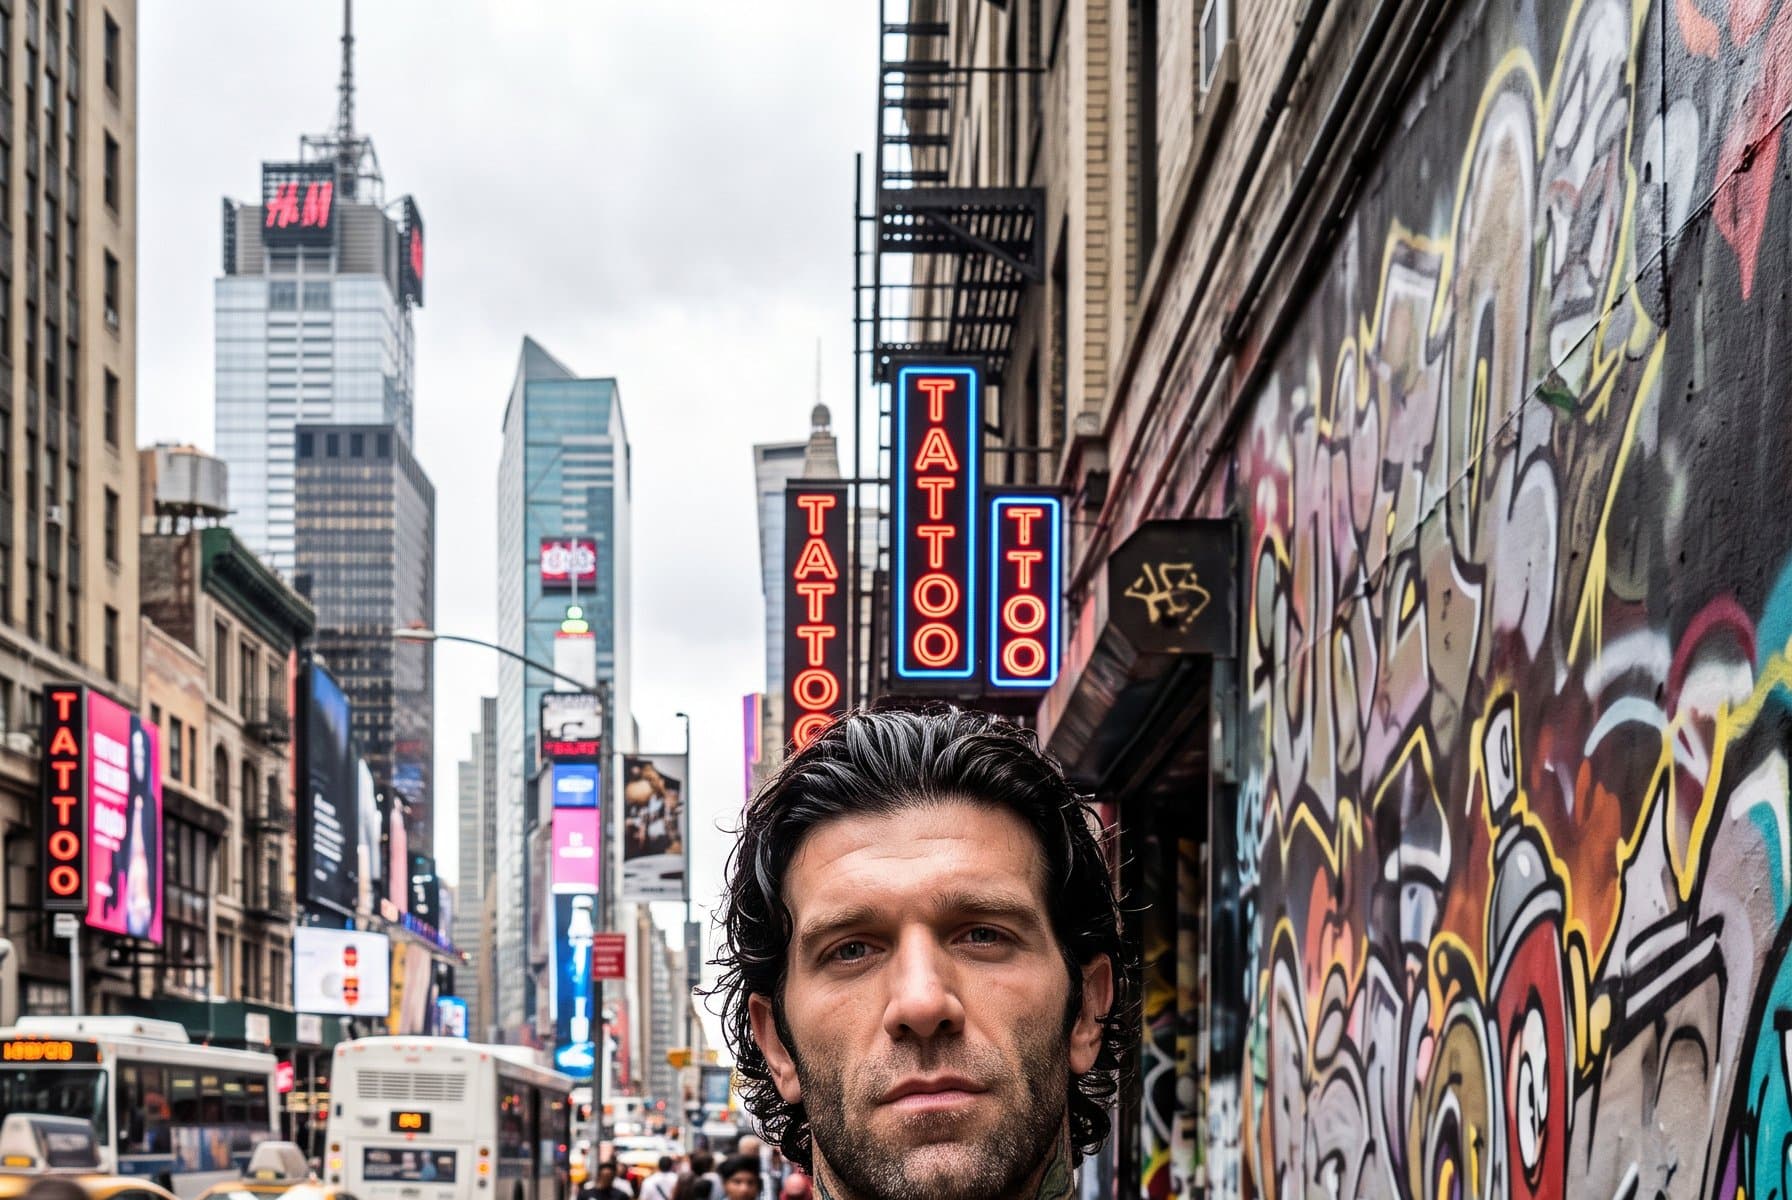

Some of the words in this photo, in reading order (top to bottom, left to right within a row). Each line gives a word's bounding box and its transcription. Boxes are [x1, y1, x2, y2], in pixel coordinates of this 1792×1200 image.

[912, 377, 960, 668] TATTOO
[1002, 507, 1047, 677] TTOO
[49, 691, 80, 896] TATTOO
